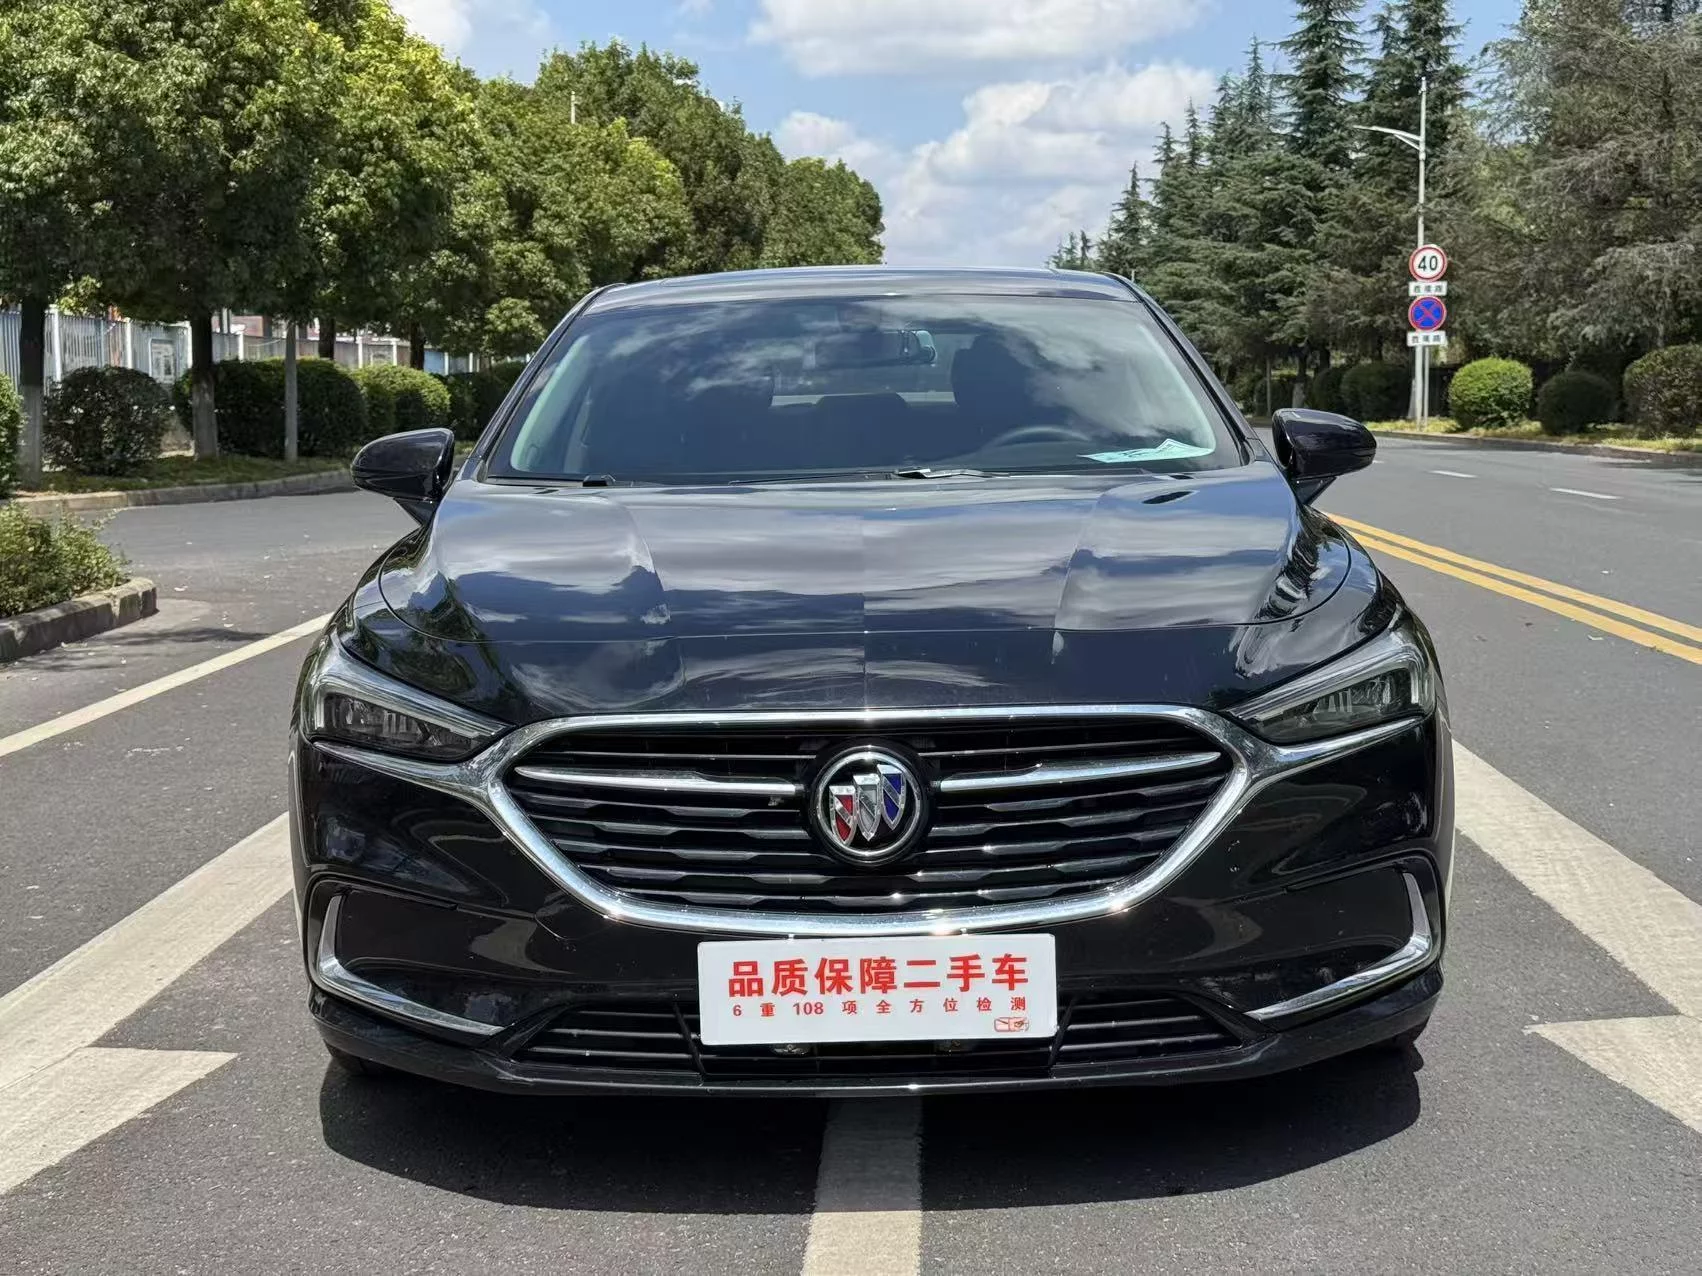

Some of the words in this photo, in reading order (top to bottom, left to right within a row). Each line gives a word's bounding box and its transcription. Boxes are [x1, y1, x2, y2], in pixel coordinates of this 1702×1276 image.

[1417, 255, 1438, 272] 40
[728, 953, 1028, 998] 品质保障二手车
